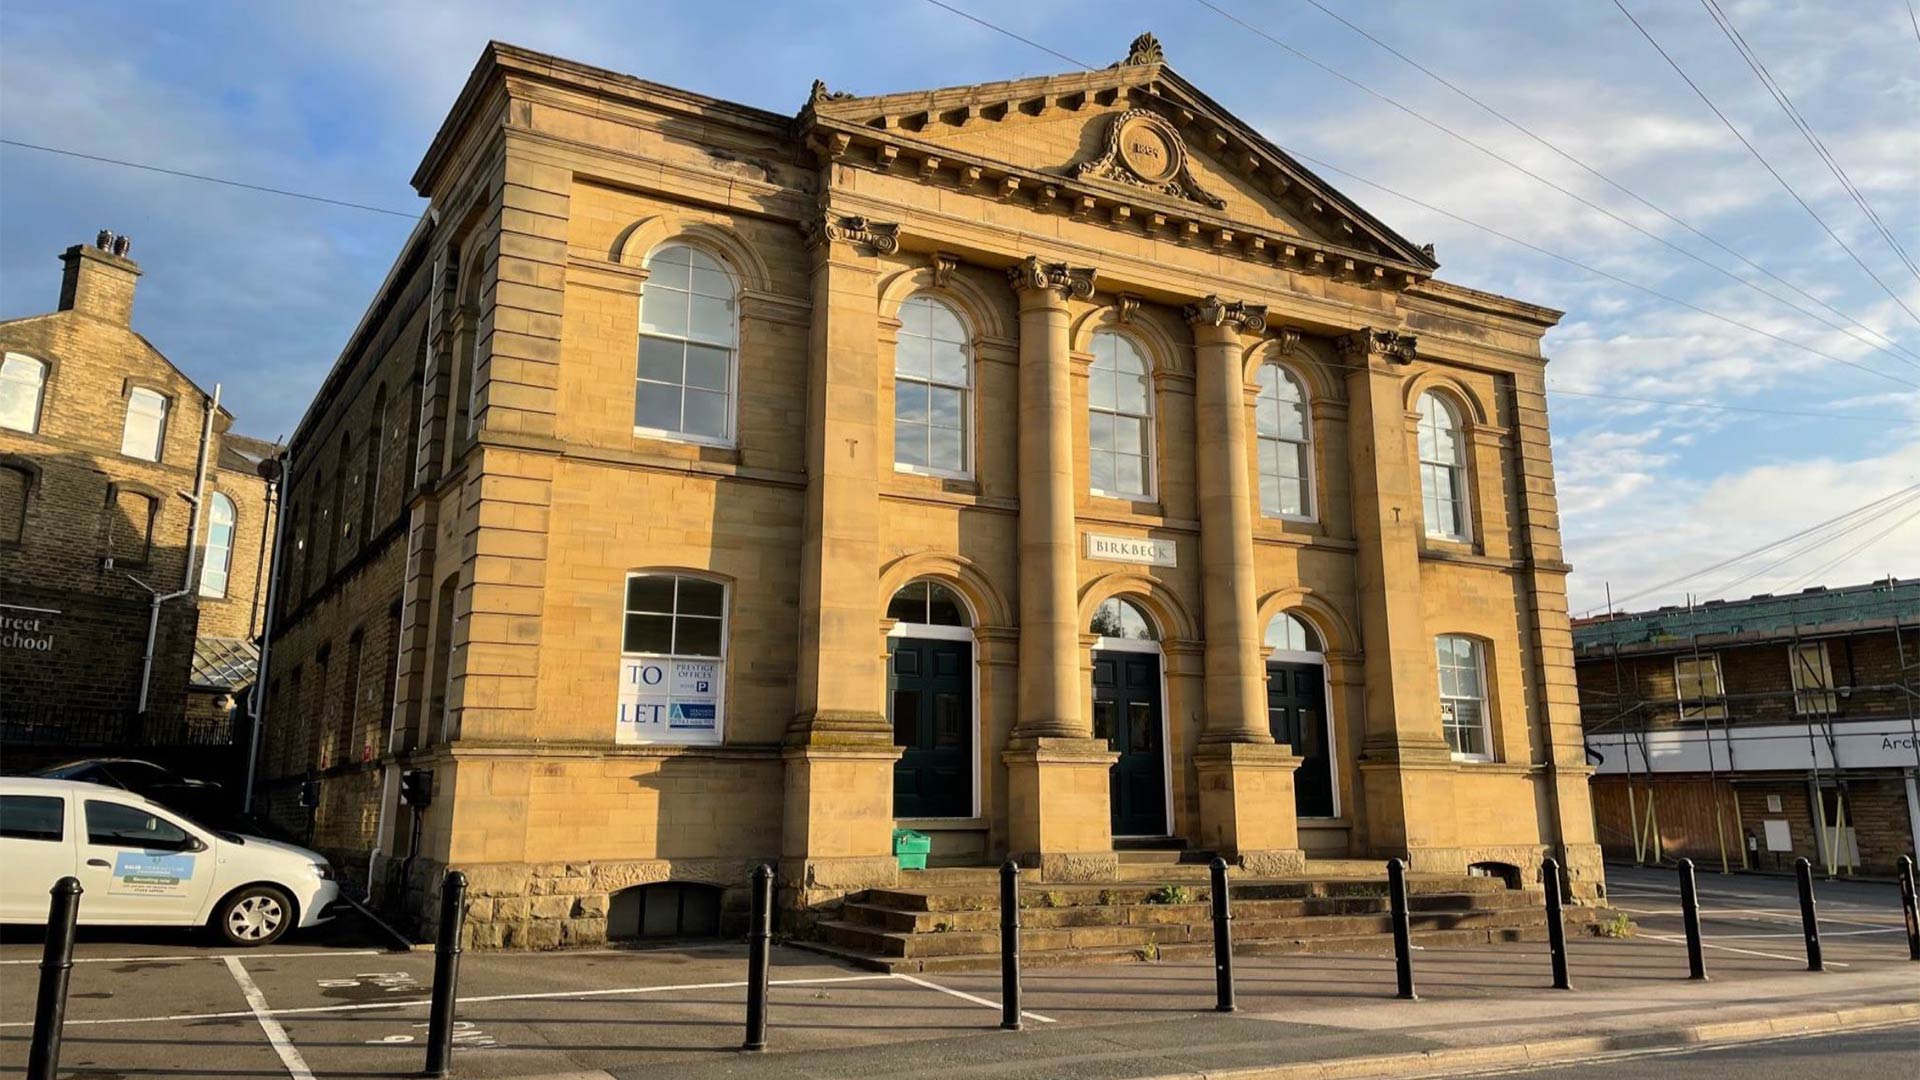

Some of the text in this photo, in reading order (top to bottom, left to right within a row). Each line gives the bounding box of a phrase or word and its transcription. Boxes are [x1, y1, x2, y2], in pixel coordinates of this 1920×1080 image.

[1096, 541, 1167, 559] BIRKBECK
[0, 631, 54, 651] chool
[627, 665, 662, 685] TO
[678, 671, 711, 679] OFFICES
[620, 704, 665, 723] LET
